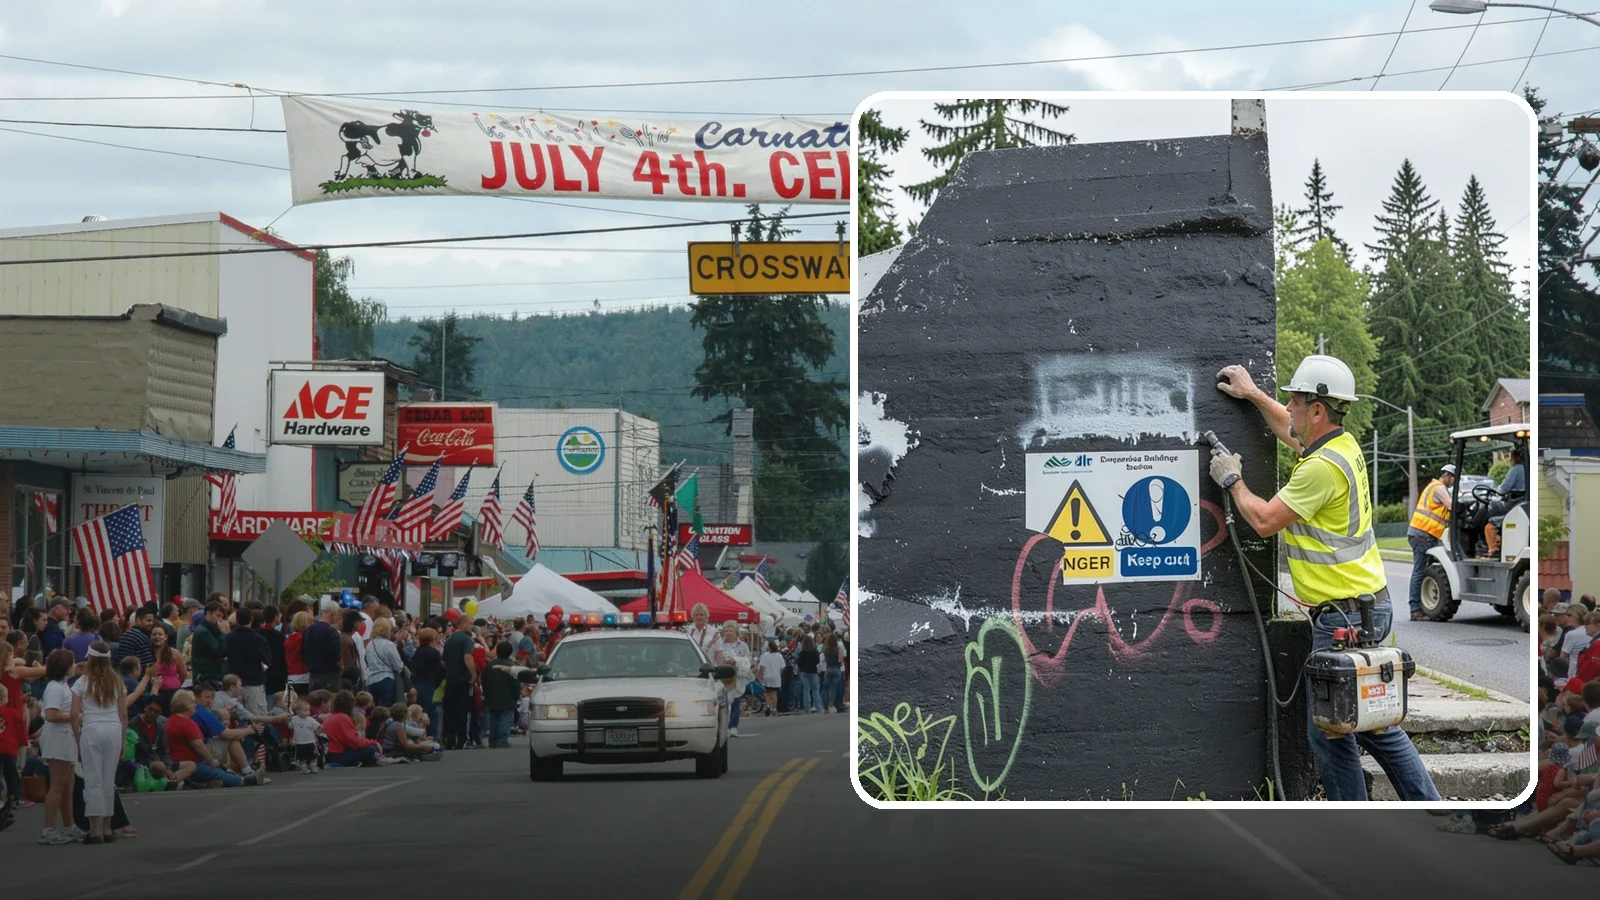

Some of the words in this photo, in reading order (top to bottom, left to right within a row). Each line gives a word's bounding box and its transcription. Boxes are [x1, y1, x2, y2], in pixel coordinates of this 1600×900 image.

[481, 141, 605, 192] JULY
[632, 150, 746, 197] 4th.
[697, 254, 850, 280] CROSSWA
[283, 380, 373, 420] ACE
[405, 409, 452, 421] CEDAR
[461, 409, 485, 421] LOG
[283, 421, 371, 436] Hardware
[353, 467, 385, 480] Simpl
[95, 484, 124, 494] Vincent
[126, 485, 135, 494] de
[137, 485, 155, 495] Paul
[81, 503, 153, 521] THRT
[688, 526, 741, 534] CRNATION
[699, 535, 730, 543] GLASS
[1127, 553, 1161, 569] Keep
